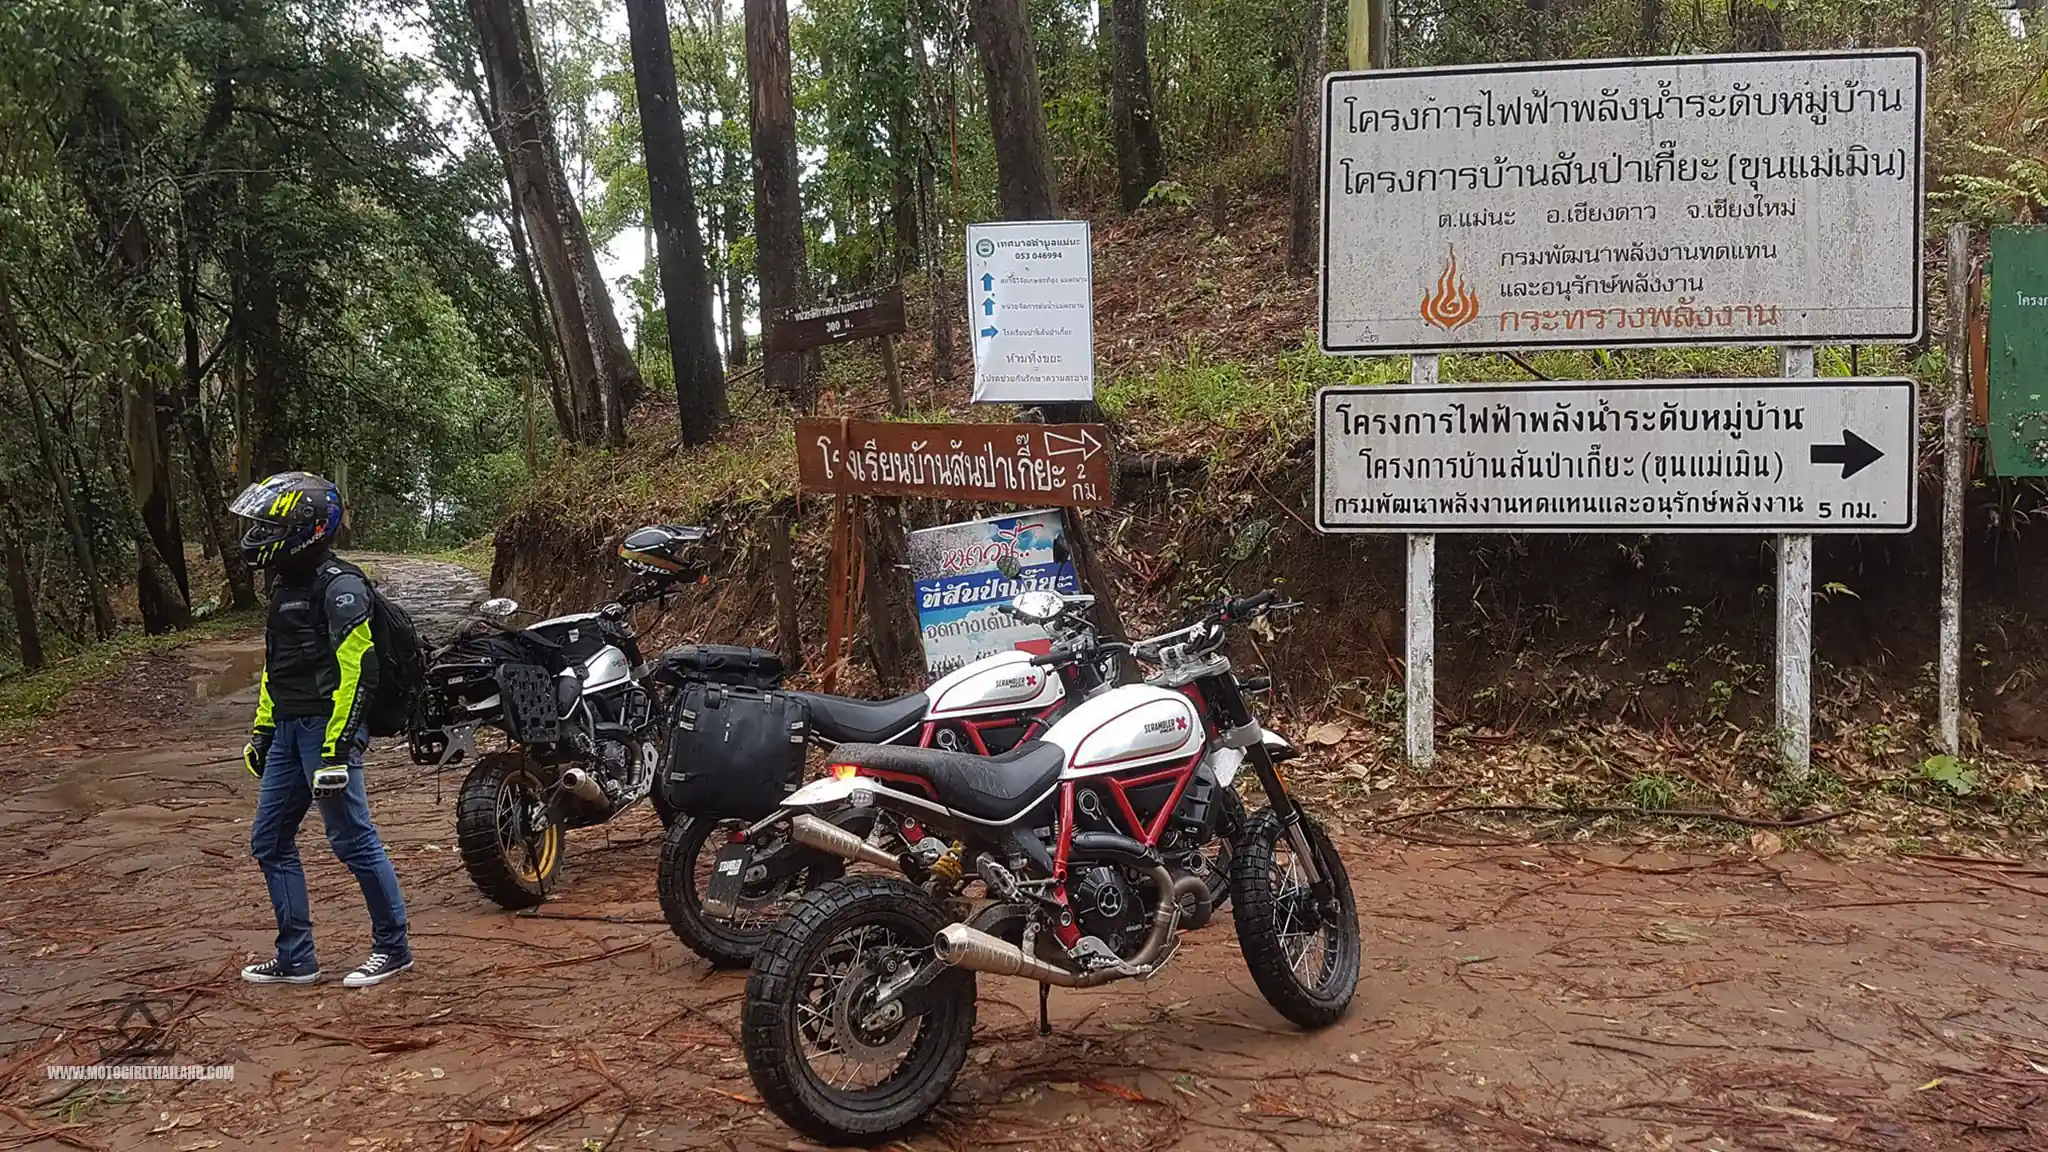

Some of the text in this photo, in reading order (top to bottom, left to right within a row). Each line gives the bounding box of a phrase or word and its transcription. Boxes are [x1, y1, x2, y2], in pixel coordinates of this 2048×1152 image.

[1344, 80, 1903, 134] โครงการไฟฟ้าพลังน้ำระดับหมู่บ้าน
[1340, 140, 1905, 194] โครงการบ้านสันป่าเกี๊ยะ (ขุนแม่เมิน)
[1438, 193, 1796, 229] ต.แม่นะ อ.เชียงดาว จ.เชียงใหม่
[1015, 251, 1062, 260] 053 046994
[1500, 241, 1777, 267] กรมพัฒนาพลังงานทดแทน
[1500, 274, 1704, 301] และอนุรักษ์พลังงาน
[825, 320, 840, 333] 300
[1499, 296, 1778, 332] กระทรวงพลังงาน
[1336, 399, 1804, 440] โครงการไฟฟ้าพลังน้ำระดับหมู่บ้าน
[1076, 464, 1087, 480] 2
[1359, 444, 1785, 486] โครงการบ้านสันป่าเกี๊ยะ (ขุนแม่เมิน)
[1335, 490, 1878, 521] กรมพัฒนาพลังงานทดแทนและอนุรักษ์พลังงาน 5 กม.
[996, 677, 1026, 688] SCRAMBLER
[1143, 718, 1176, 733] SCRAMBLER
